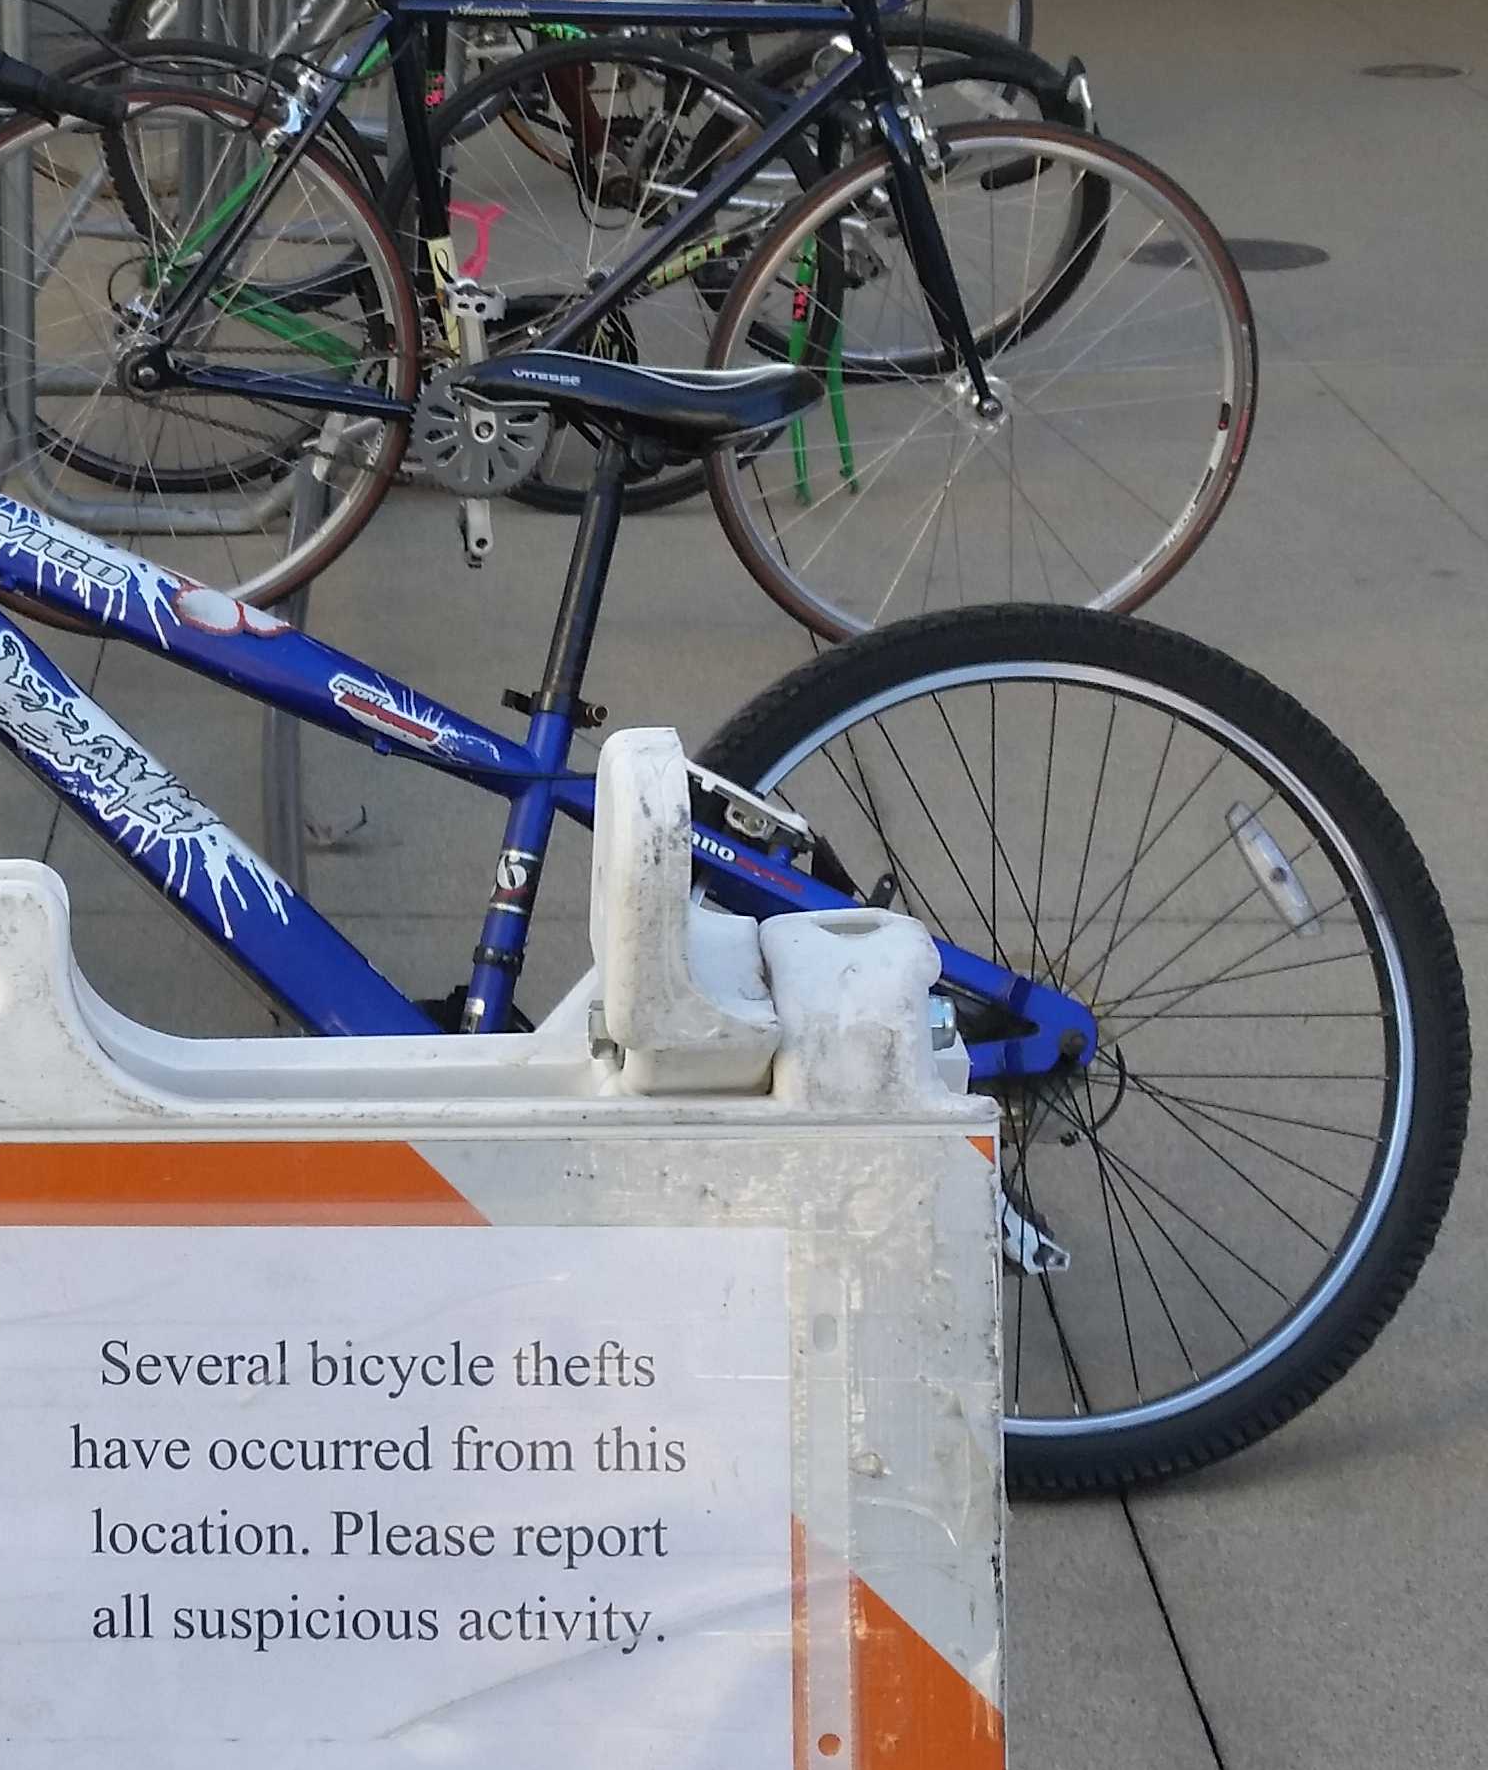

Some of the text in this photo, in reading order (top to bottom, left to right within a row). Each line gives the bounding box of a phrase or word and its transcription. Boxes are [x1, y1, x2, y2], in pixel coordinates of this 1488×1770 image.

[333, 678, 390, 708] FRONT
[102, 1340, 655, 1399] Several bicycle thefts
[70, 1423, 685, 1472] have occurred from this
[92, 1507, 668, 1569] location. Please report
[93, 1593, 664, 1654] all suspicious activity.
